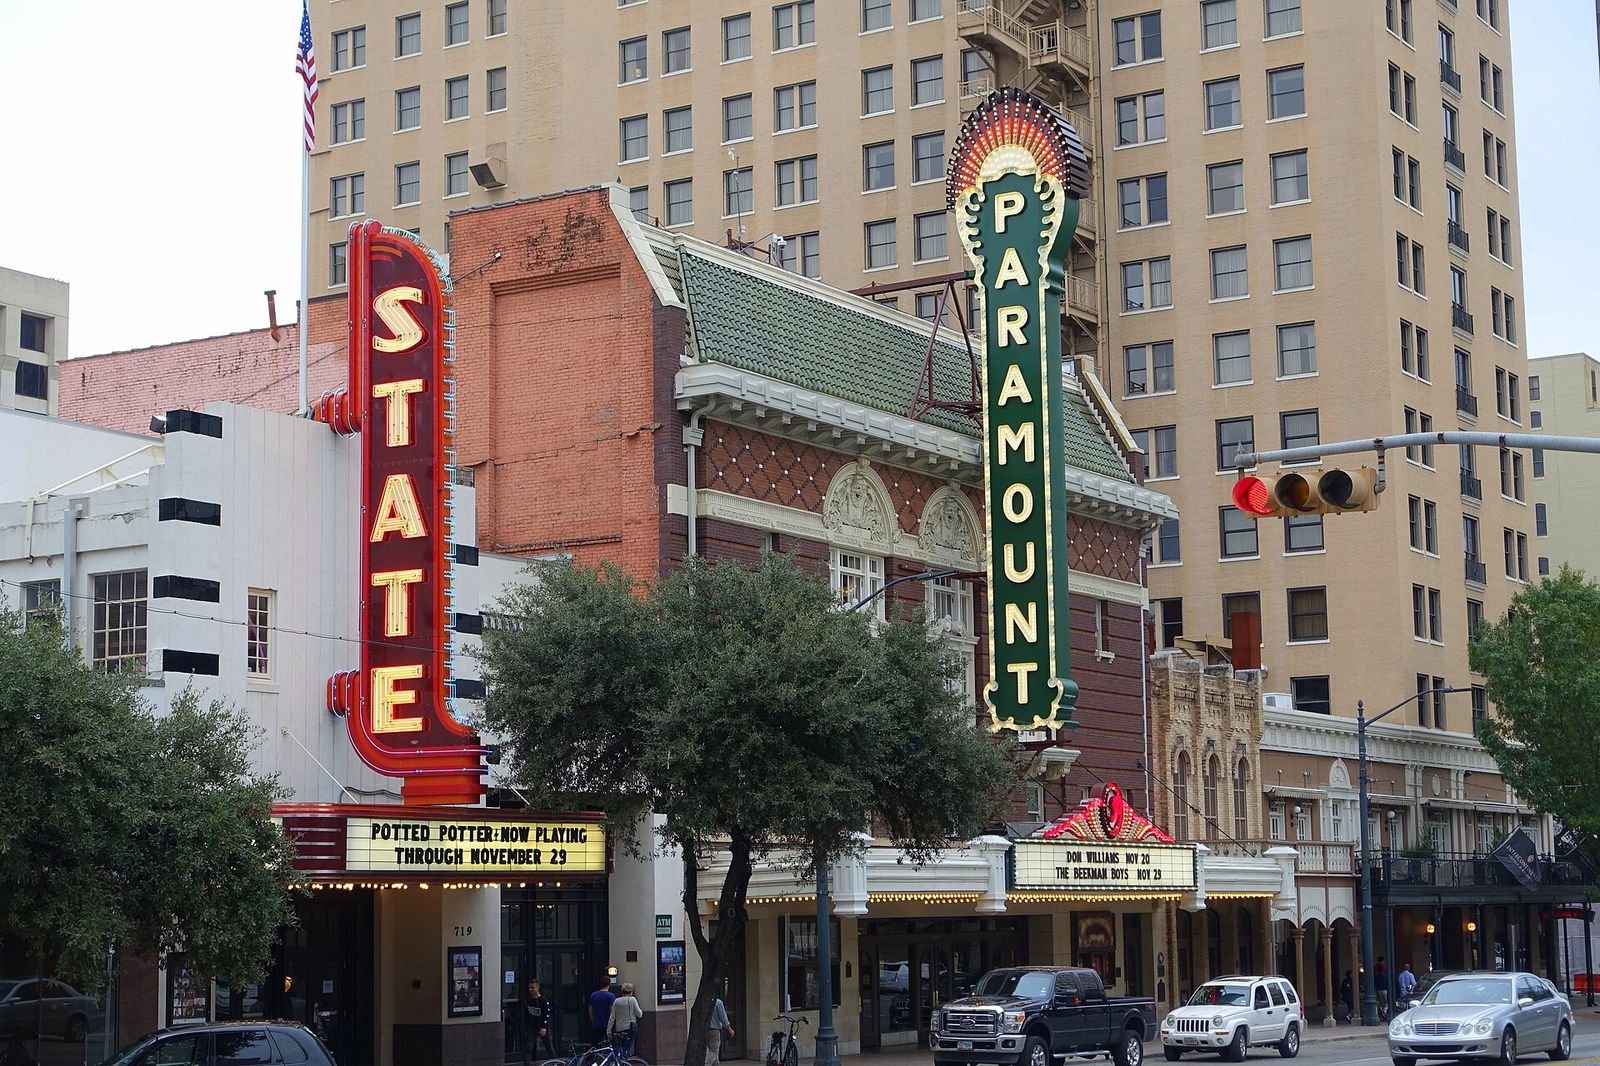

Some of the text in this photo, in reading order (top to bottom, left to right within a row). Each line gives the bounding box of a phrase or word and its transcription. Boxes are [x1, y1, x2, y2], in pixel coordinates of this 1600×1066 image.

[994, 191, 1039, 704] PARAMOUNT
[370, 285, 425, 734] STATE
[372, 823, 588, 844] POTTED POTTER NOW PLAYING
[395, 847, 567, 865] THROUGH NOVEMBER 29
[1066, 851, 1150, 865] DON WILLIAMS NOV 20
[1056, 867, 1162, 881] THE BEEKMAN BOYS NOV 29
[656, 918, 671, 926] ATM
[454, 926, 472, 936] 719
